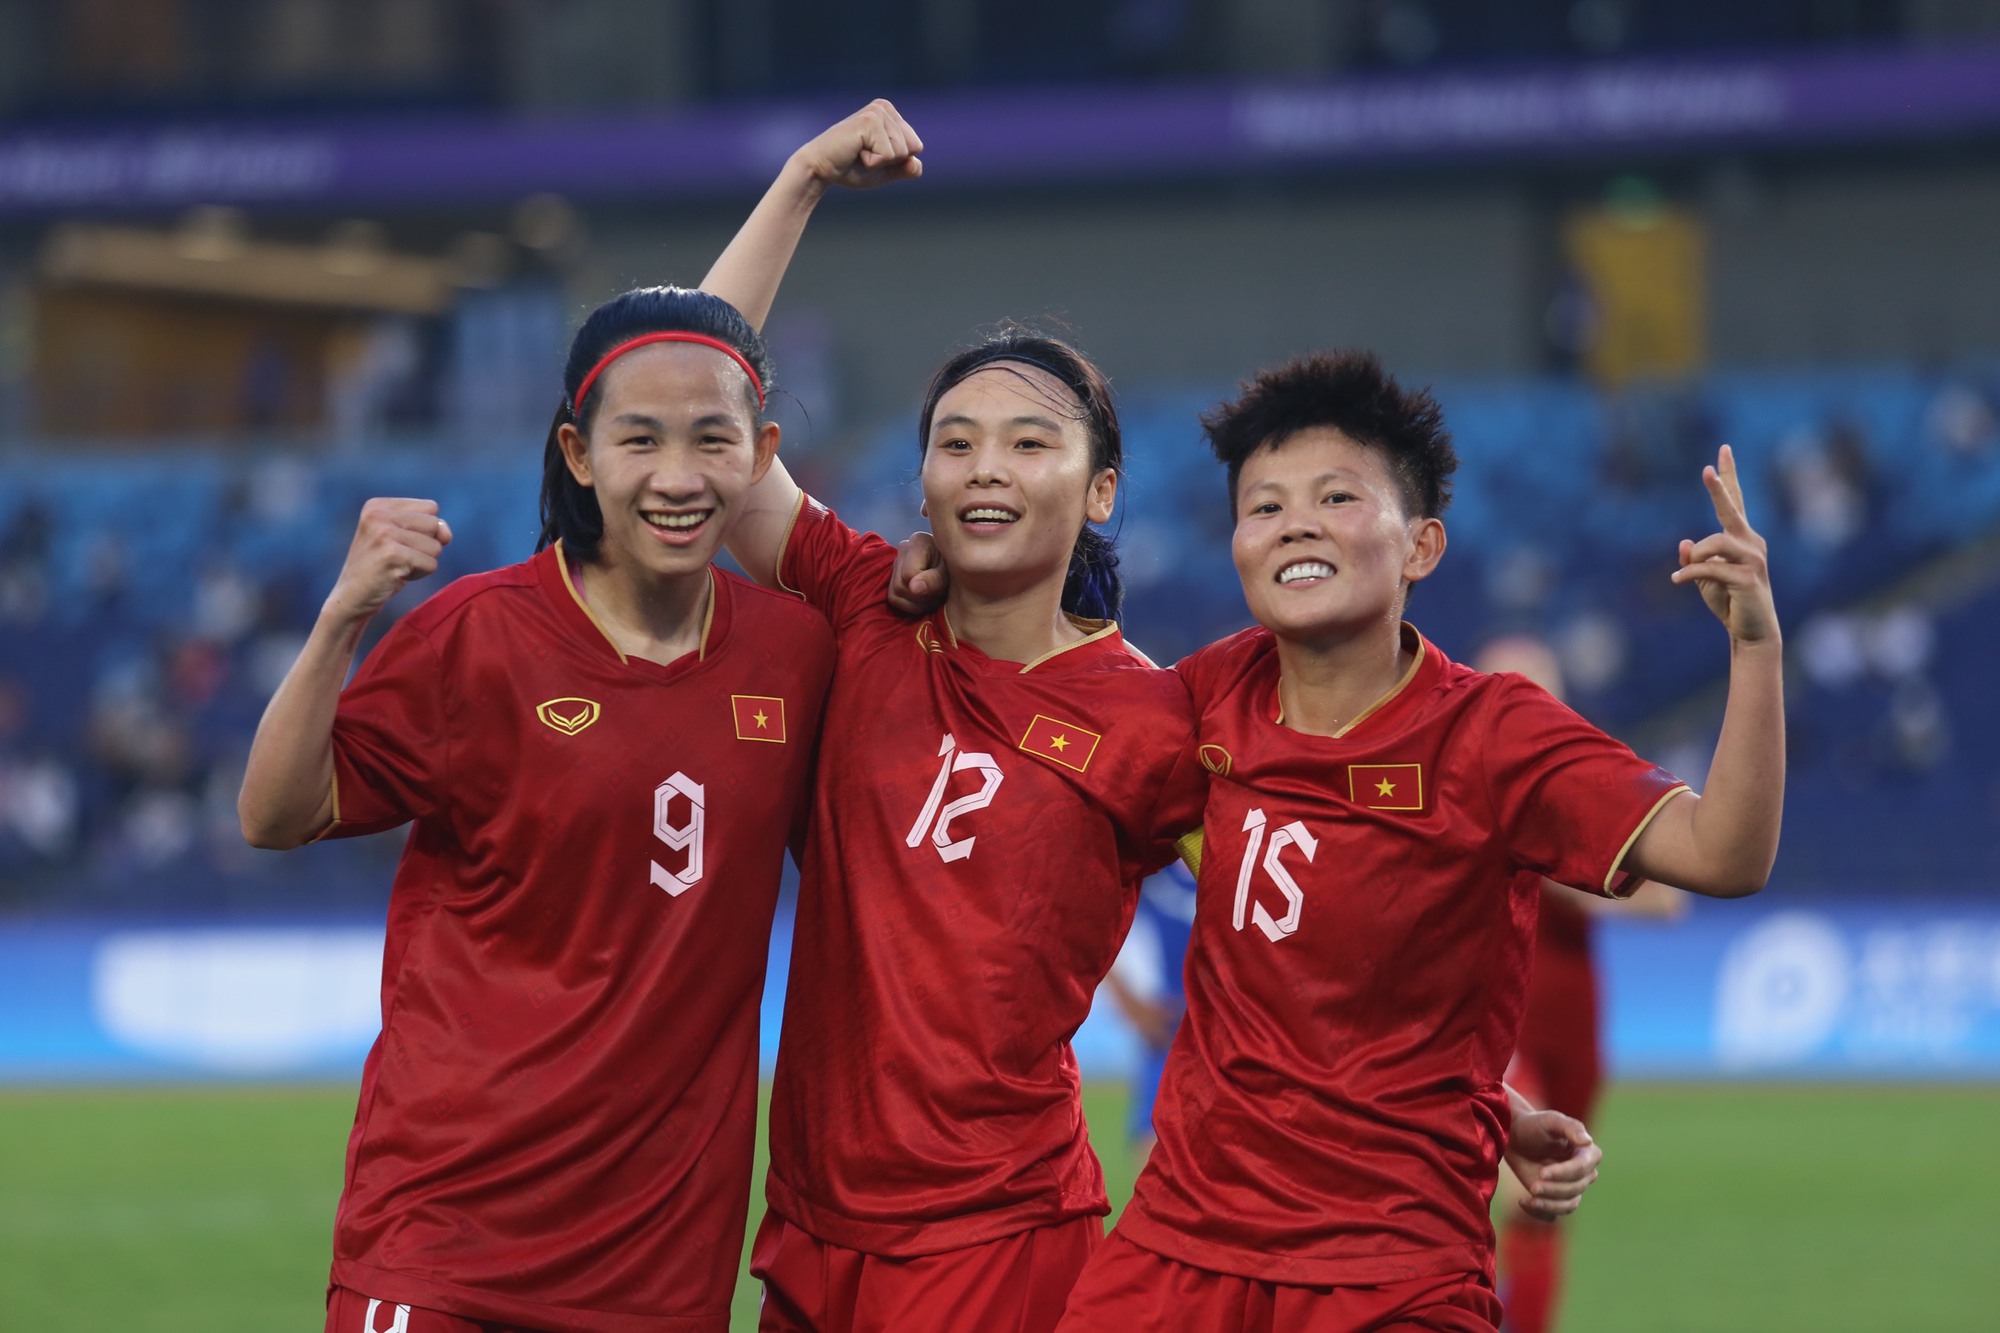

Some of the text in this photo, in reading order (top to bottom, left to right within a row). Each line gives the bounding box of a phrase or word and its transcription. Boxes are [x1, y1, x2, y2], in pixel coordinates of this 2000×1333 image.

[650, 771, 705, 897] 9
[905, 733, 1004, 863] 12
[1232, 808, 1319, 943] 15
